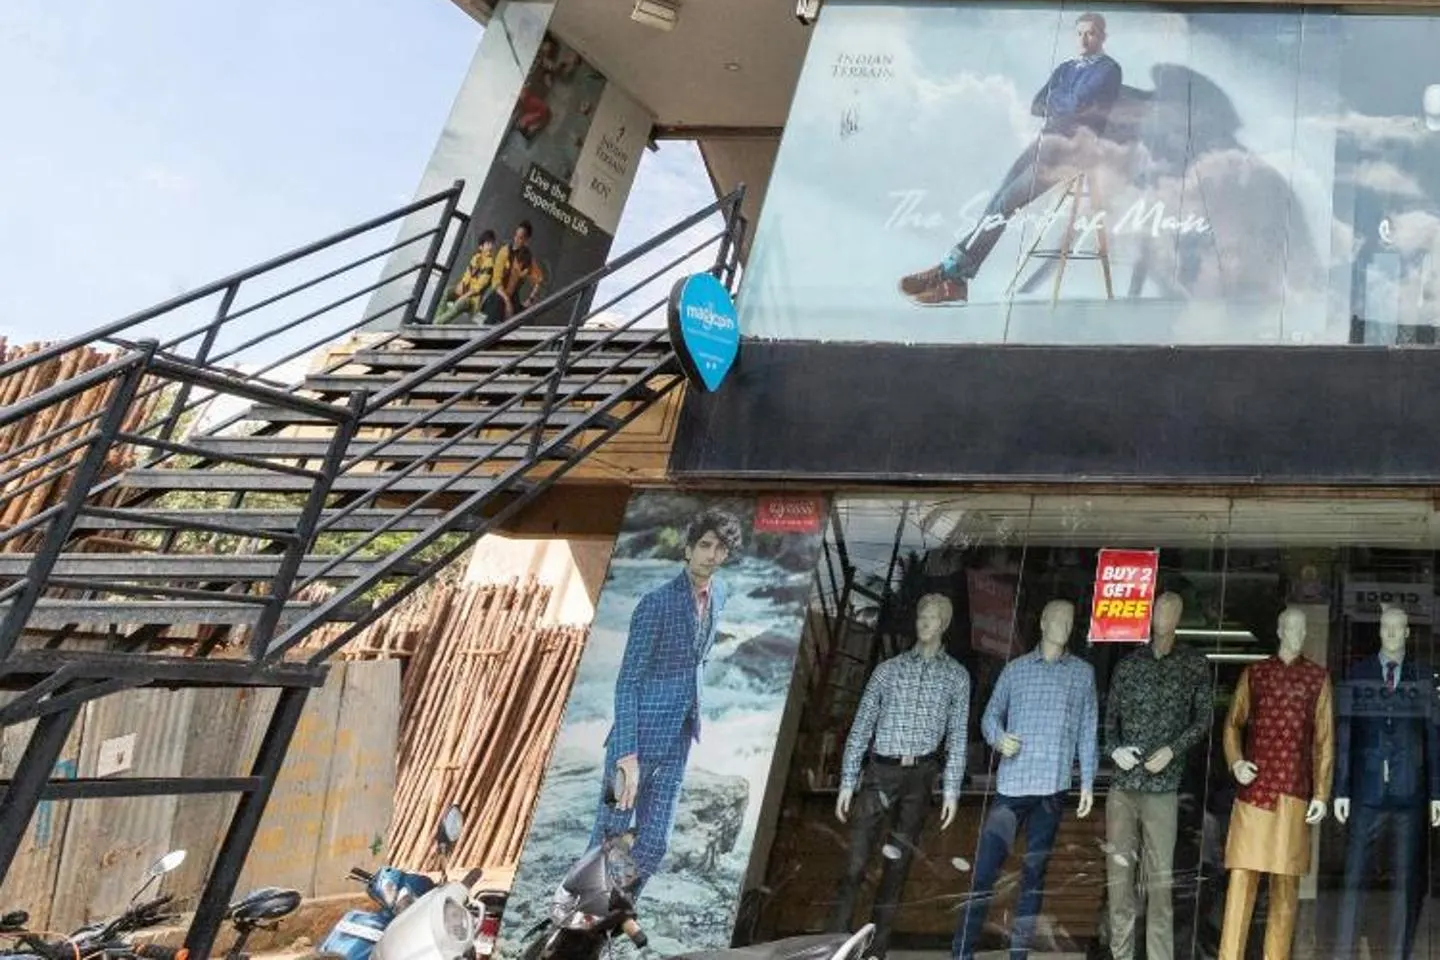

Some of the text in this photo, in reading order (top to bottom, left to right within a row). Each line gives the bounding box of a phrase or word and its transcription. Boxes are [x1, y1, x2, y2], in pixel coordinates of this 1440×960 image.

[837, 53, 894, 65] INDIAN
[529, 168, 567, 202] Live the
[523, 185, 571, 224] Superhero
[885, 191, 1212, 255] The Spirit of Man
[1102, 566, 1153, 582] BUY 2
[1103, 583, 1149, 597] GET 1
[1096, 599, 1150, 618] FREE
